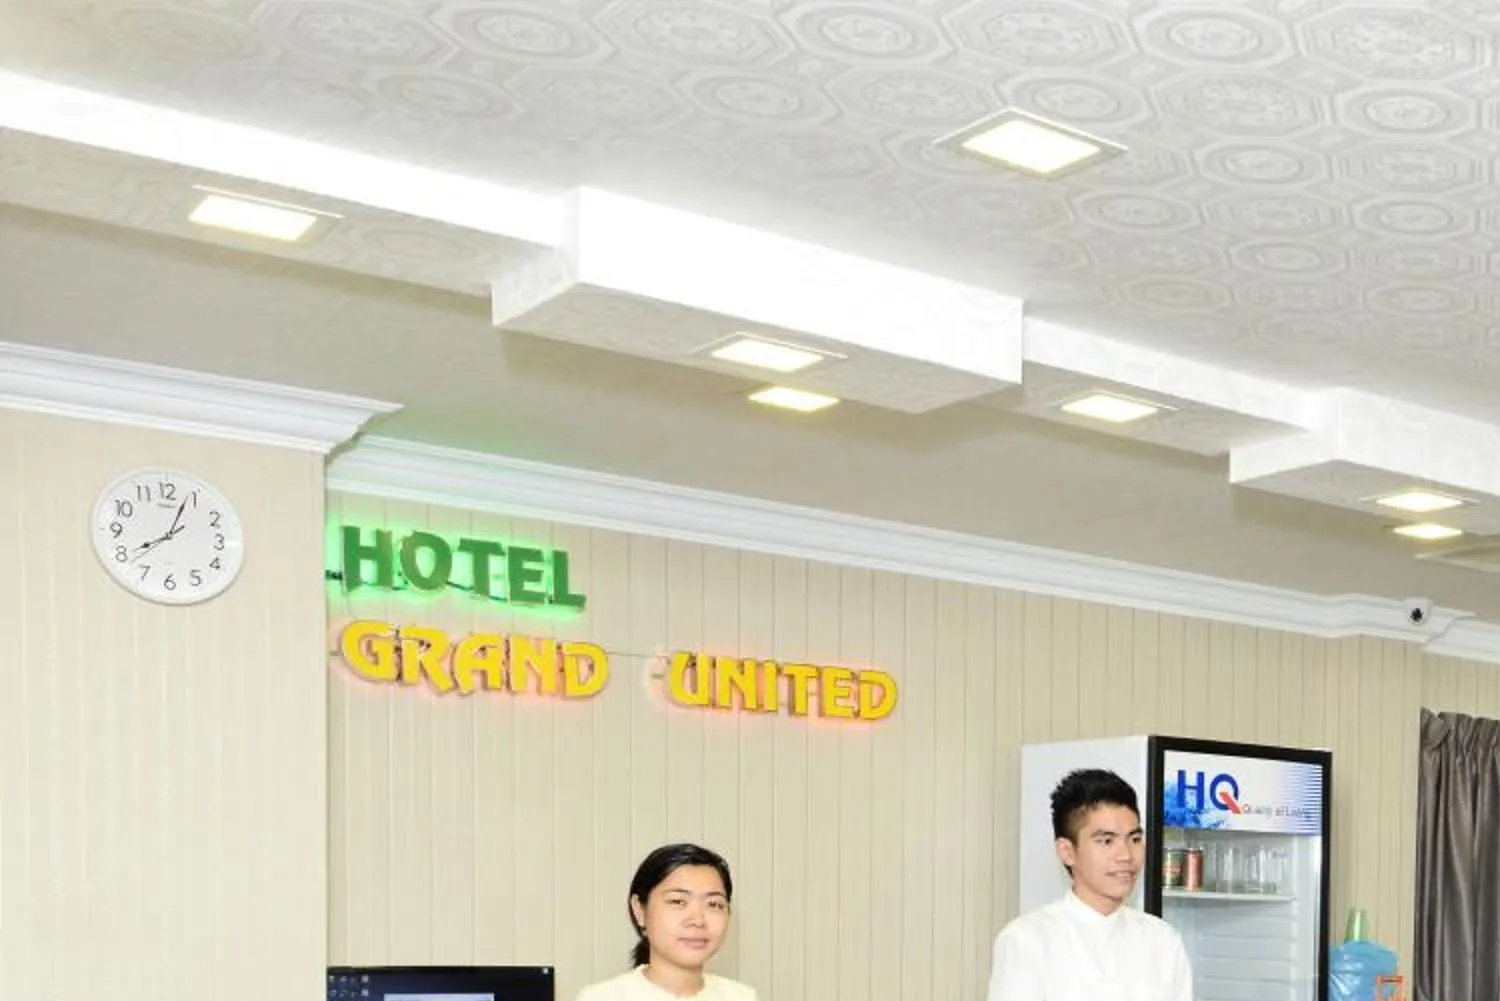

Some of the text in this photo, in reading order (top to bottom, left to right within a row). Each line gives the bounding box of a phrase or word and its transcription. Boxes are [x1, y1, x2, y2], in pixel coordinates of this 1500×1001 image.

[136, 484, 151, 502] 11
[159, 482, 177, 501] 12
[191, 491, 198, 508] 1
[115, 499, 134, 518] 10
[209, 510, 221, 528] 2
[109, 521, 123, 539] 9
[213, 533, 225, 551] 3
[114, 544, 128, 563] 8
[208, 556, 221, 570] 4
[341, 525, 587, 609] HOTEL
[138, 564, 151, 581] 7
[189, 569, 202, 587] 5
[163, 573, 177, 591] 6
[339, 619, 898, 722] GRAND UNITED
[1177, 769, 1242, 815] HQ
